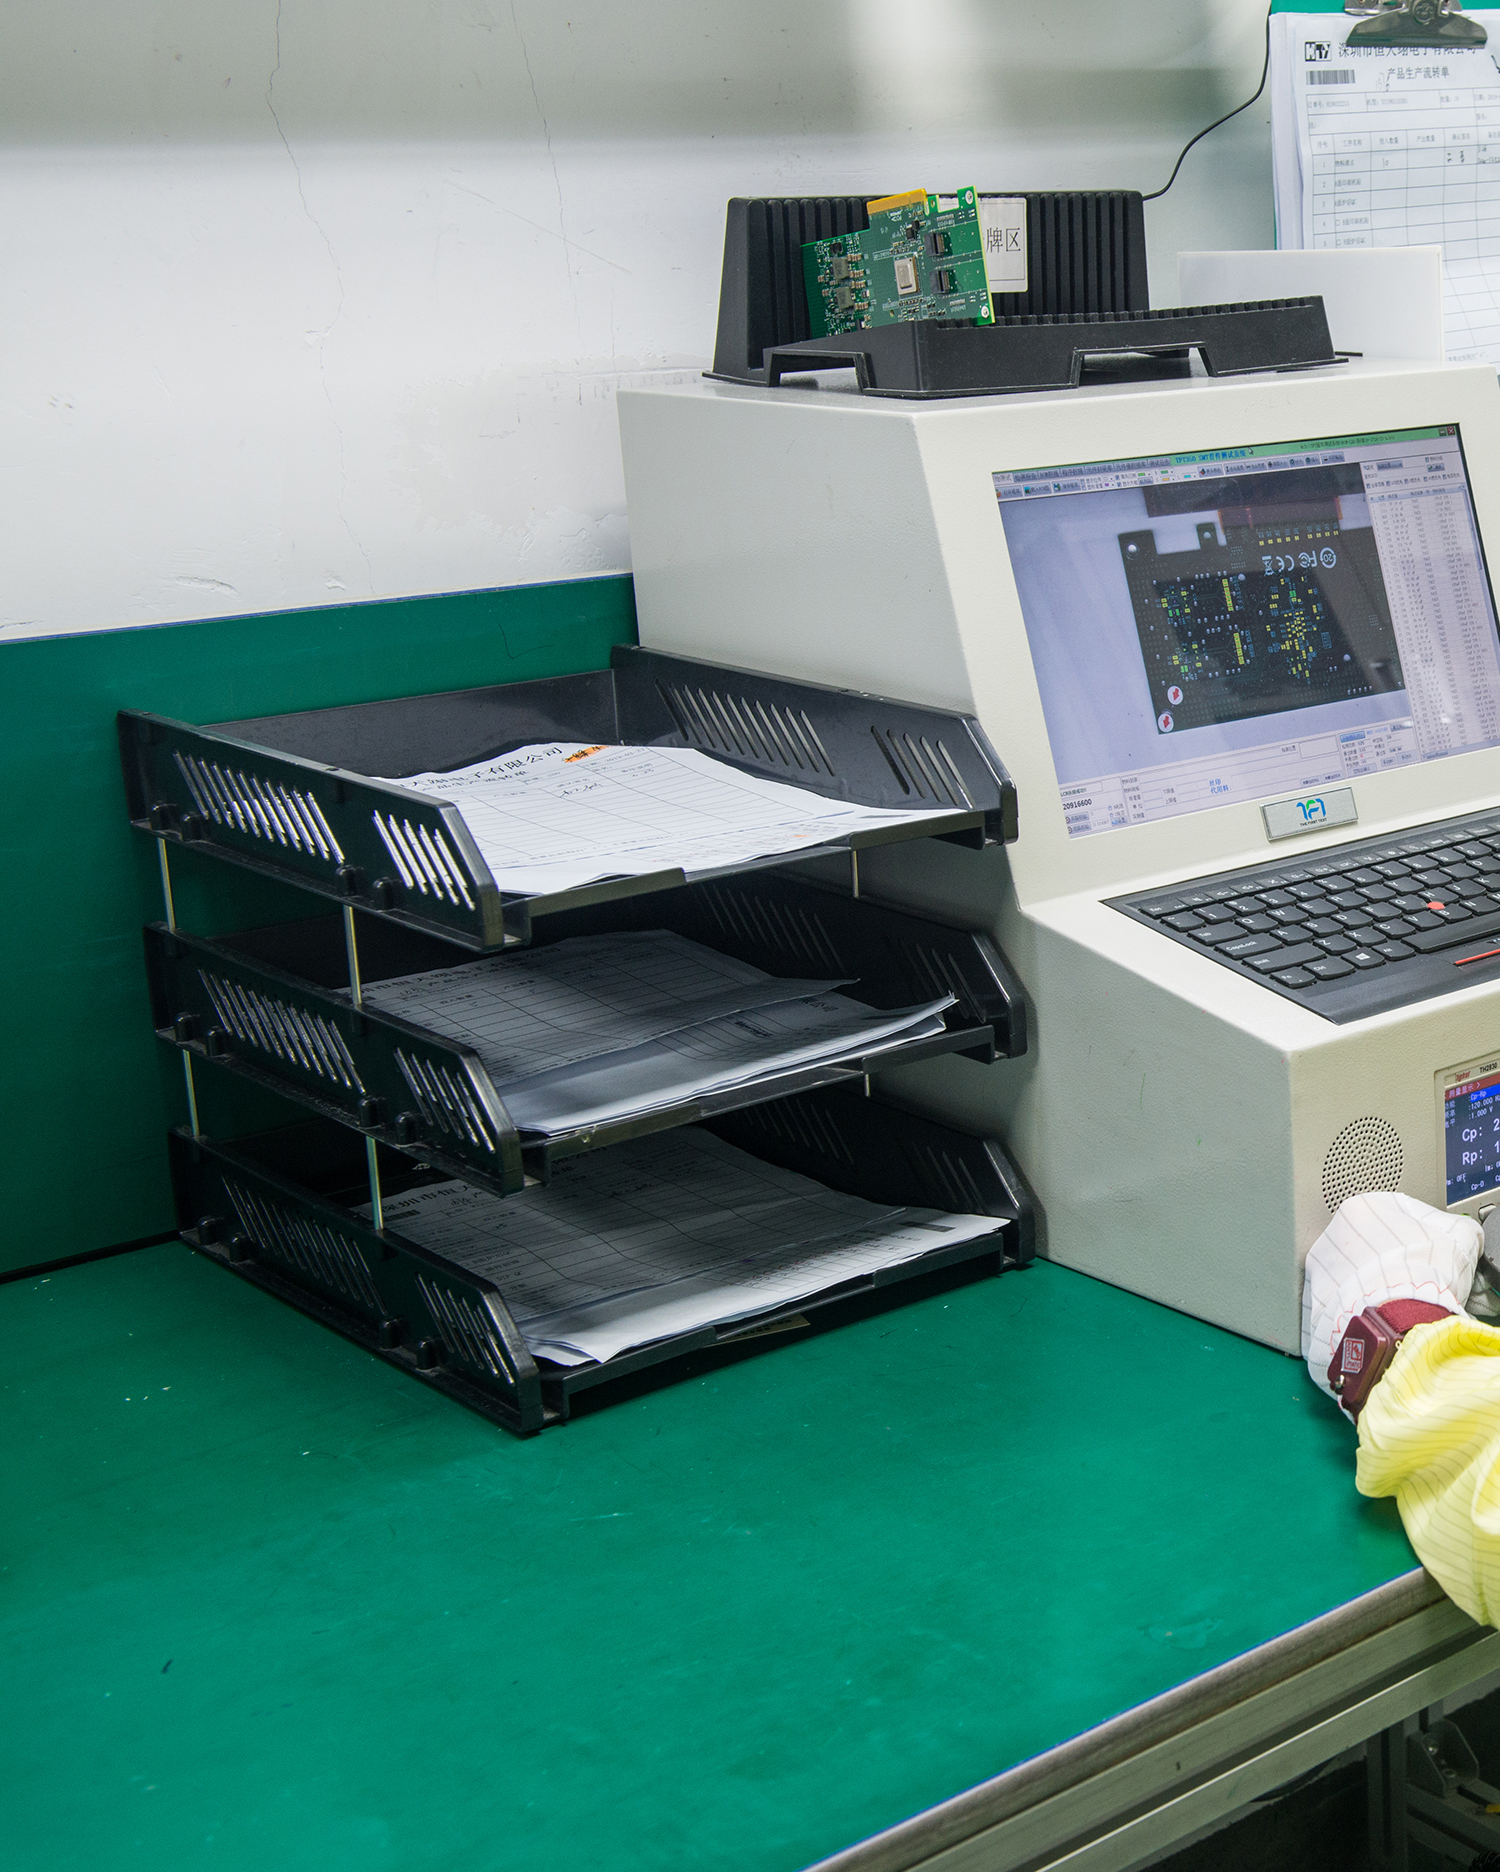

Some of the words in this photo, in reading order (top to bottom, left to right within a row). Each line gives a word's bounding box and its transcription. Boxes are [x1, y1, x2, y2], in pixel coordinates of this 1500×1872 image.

[1387, 66, 1450, 80] 产品生产流转单
[986, 227, 1021, 253] 牌区
[1479, 1062, 1498, 1074] TH2830
[1450, 1083, 1474, 1098] 测量显示
[1462, 1126, 1482, 1142] Cp:
[1462, 1149, 1483, 1165] Rp:
[1456, 1173, 1466, 1182] OFF
